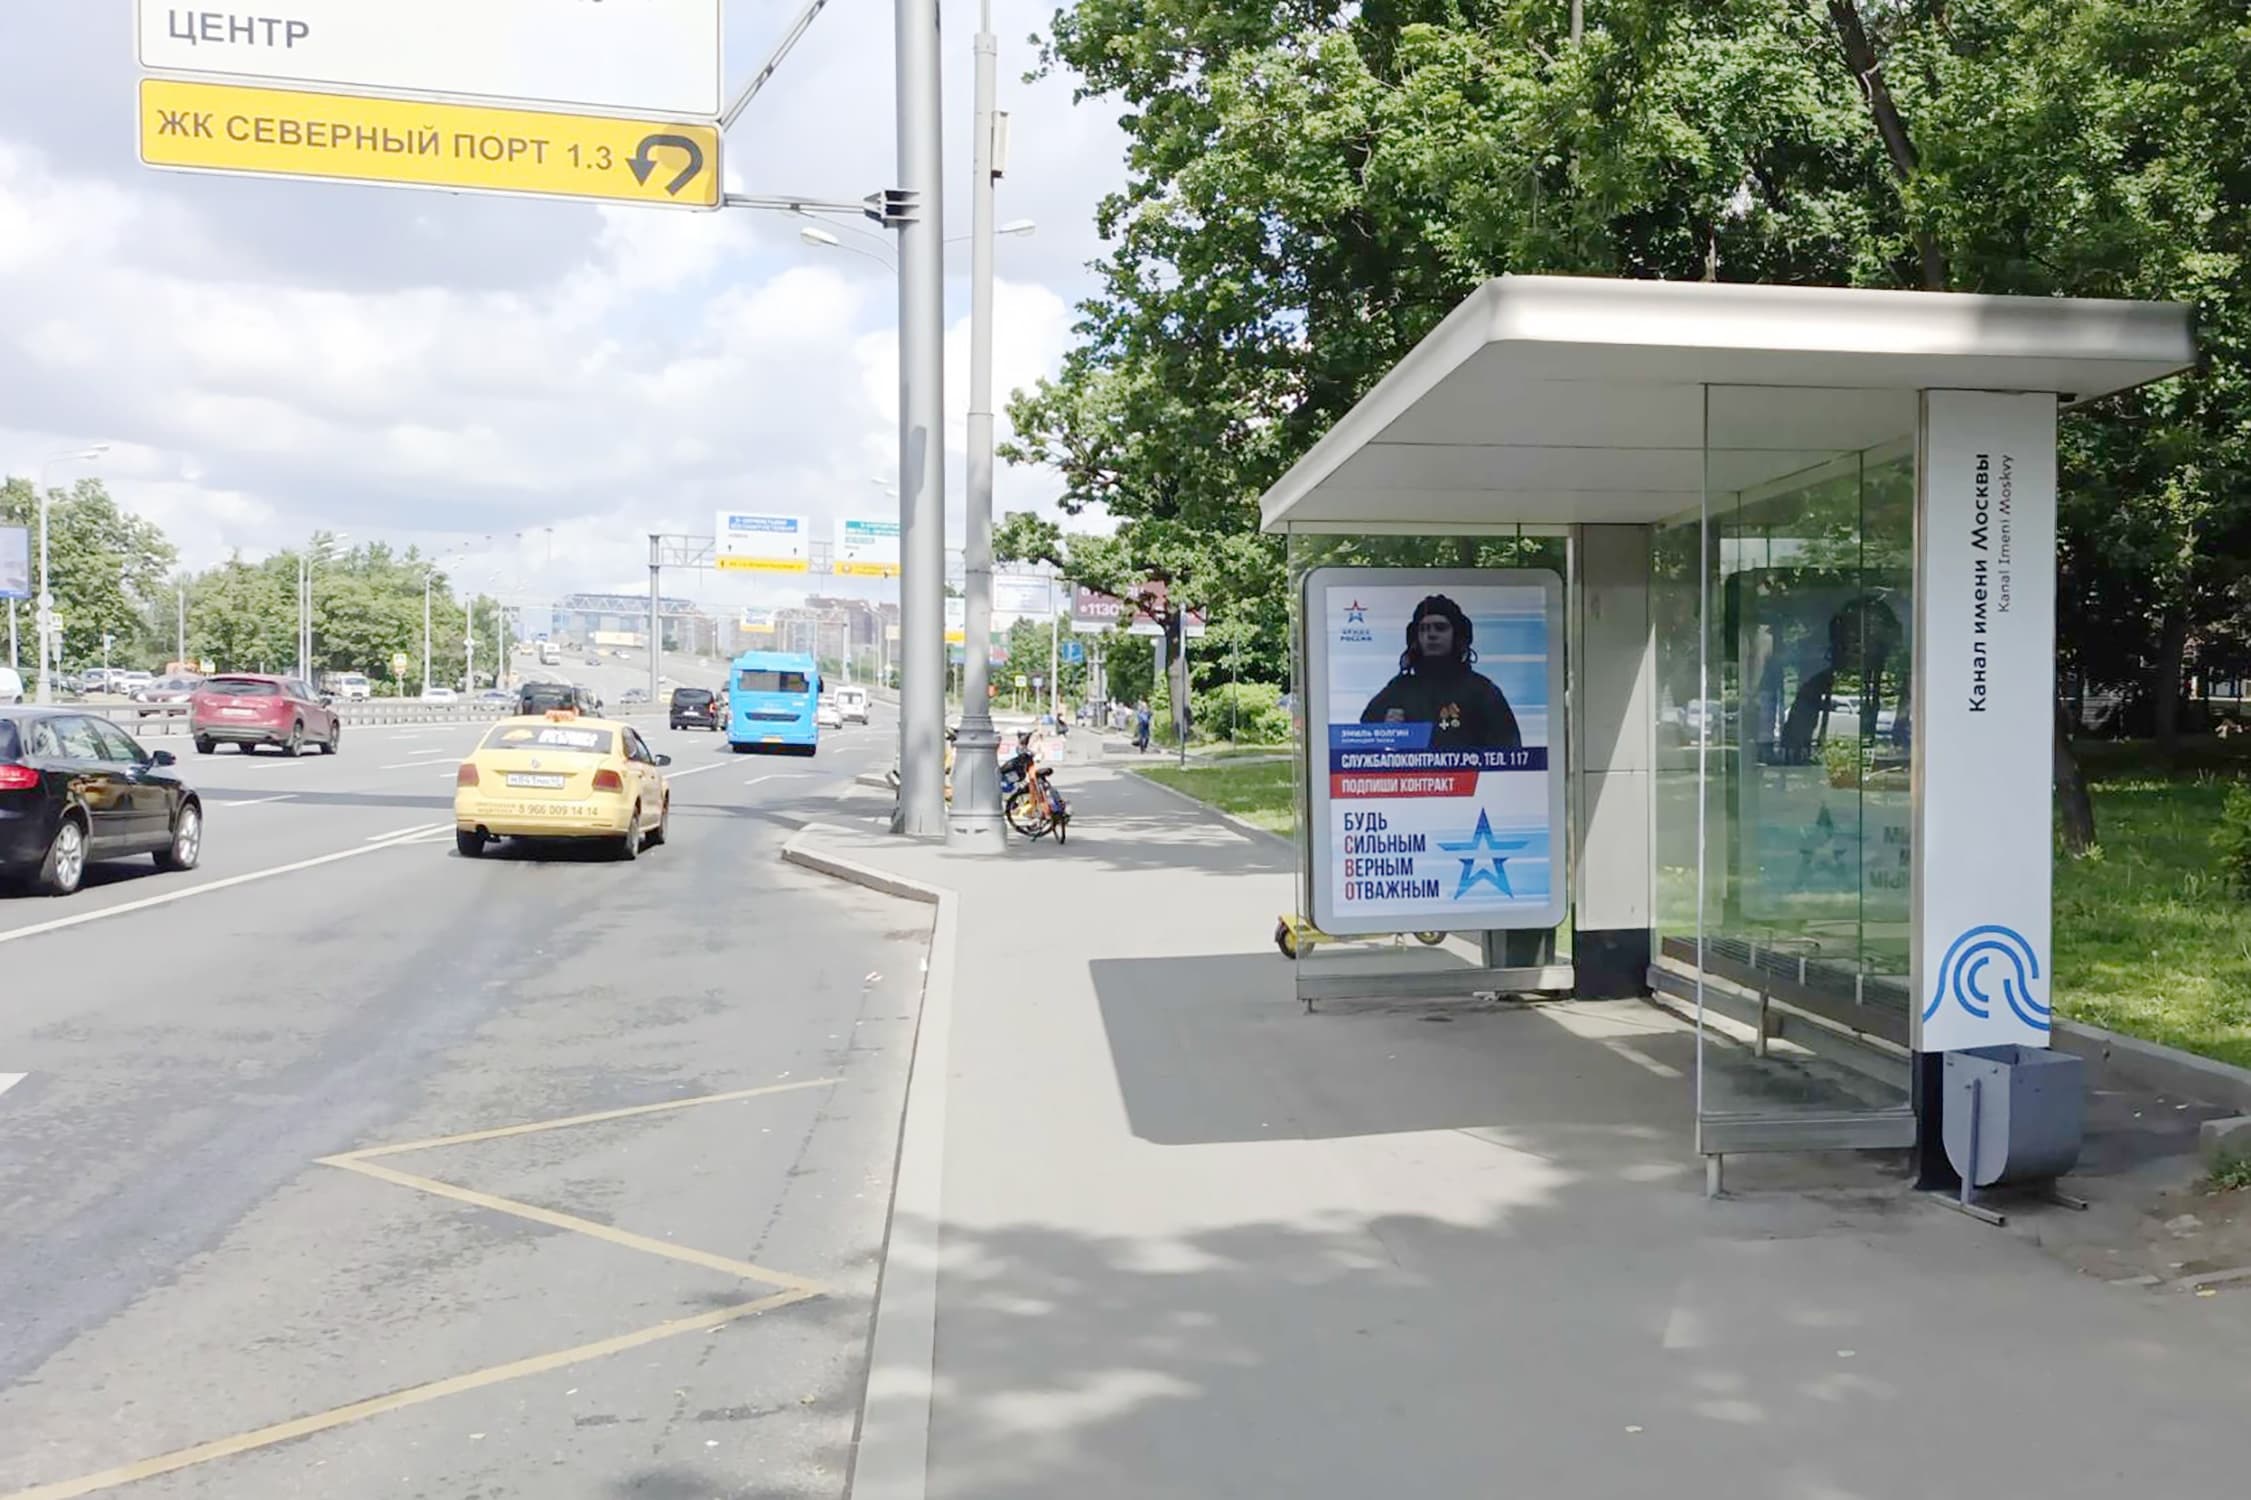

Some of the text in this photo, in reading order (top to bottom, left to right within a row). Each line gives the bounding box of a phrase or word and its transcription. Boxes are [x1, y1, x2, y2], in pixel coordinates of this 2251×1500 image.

[168, 9, 311, 49] ЦЕНТР
[156, 108, 614, 171] ЖК СЕВЕРНЫЙ ПОРТ 1.3
[1997, 455, 2015, 613] Kanal Imeni Moskvy
[1968, 453, 1990, 713] Канал имени Москвы
[1510, 751, 1529, 766] 117
[1341, 776, 1455, 795] ПОДПИШИ КОНТРАКТ
[1344, 811, 1388, 833] БУДЬ
[1344, 833, 1426, 855] СИЛЬНЫМ
[1344, 857, 1414, 877] ВЕРНЫМ
[1345, 879, 1440, 901] ОТВАЖНЫМ
